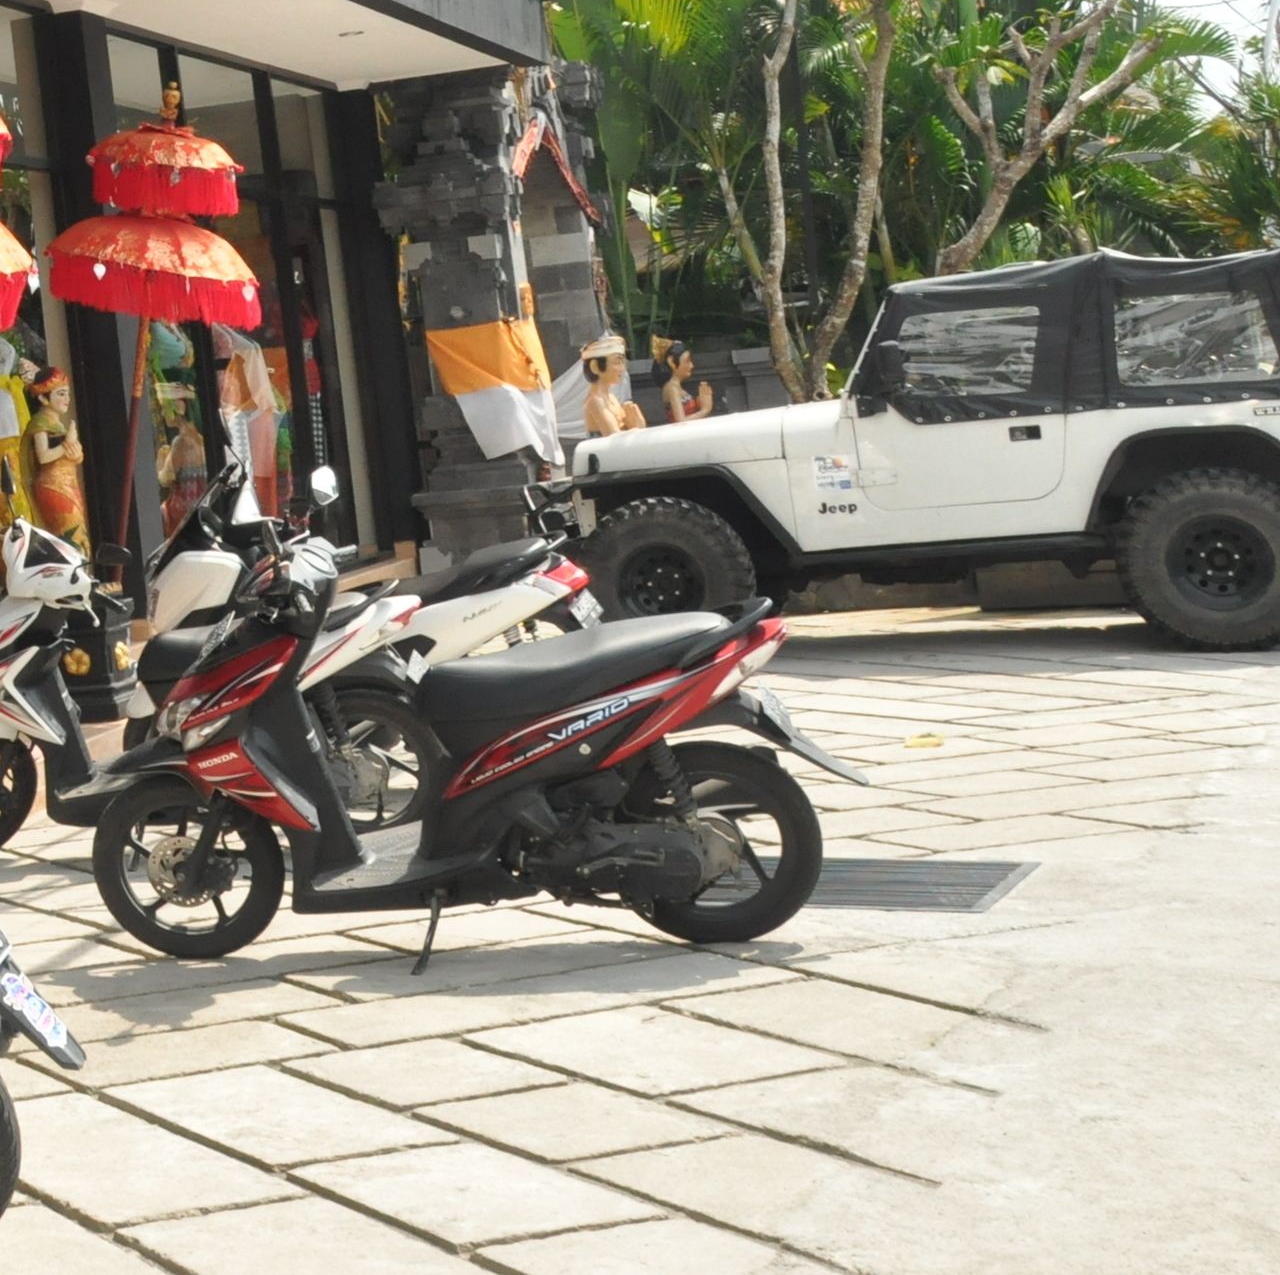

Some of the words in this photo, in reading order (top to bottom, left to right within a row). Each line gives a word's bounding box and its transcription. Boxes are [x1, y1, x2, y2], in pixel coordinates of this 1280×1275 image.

[818, 502, 858, 515] Jeep
[546, 697, 629, 741] VARIO
[197, 751, 239, 770] HONDA
